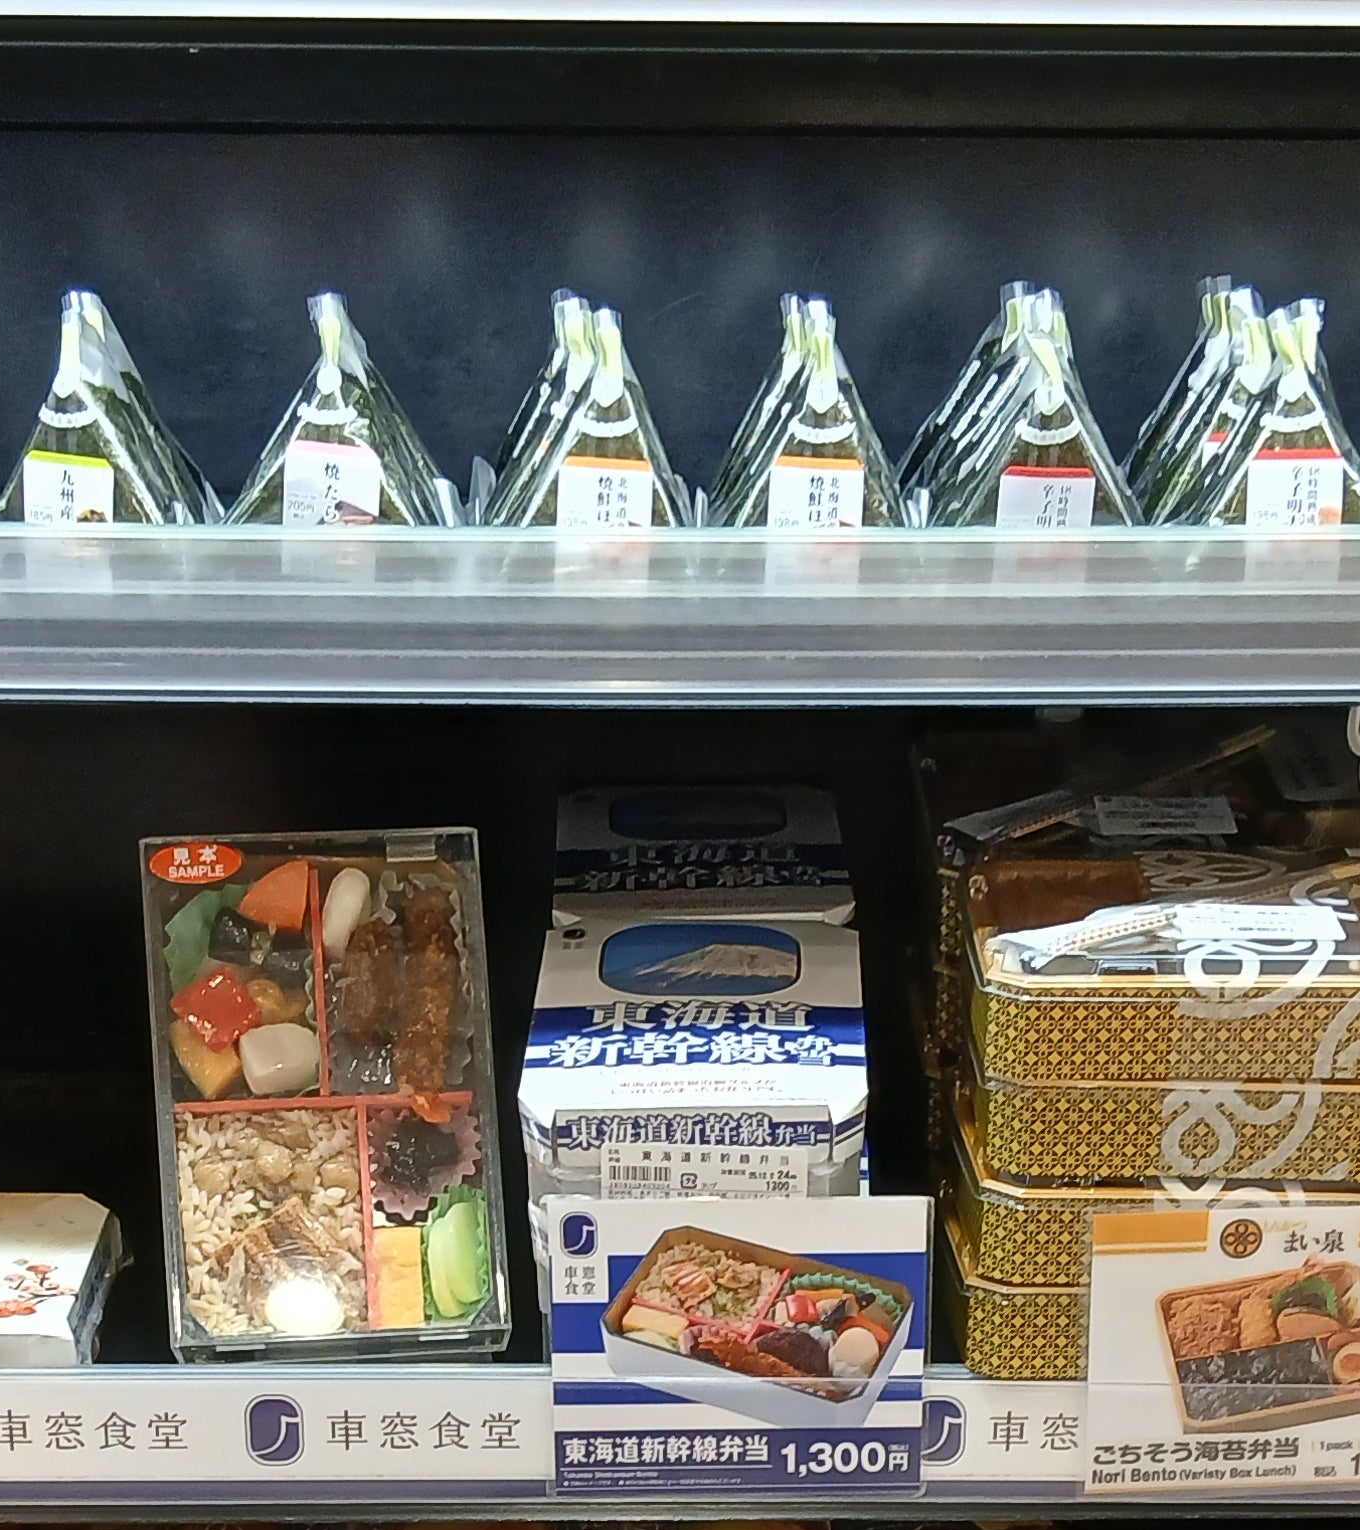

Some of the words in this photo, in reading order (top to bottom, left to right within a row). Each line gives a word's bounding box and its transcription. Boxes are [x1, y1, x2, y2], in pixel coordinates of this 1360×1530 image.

[173, 845, 217, 865] 見本
[168, 864, 225, 878] SAMPLE
[582, 1001, 816, 1033] 東海道
[566, 1112, 818, 1149] 東海道新幹線弁当
[1282, 1229, 1346, 1253] まい泉
[326, 1409, 522, 1452] 車窓食堂
[987, 1411, 1079, 1452] 車窓
[562, 1436, 770, 1465] 東海道新幹線弁当
[781, 1442, 909, 1474] 1,300円
[1093, 1438, 1300, 1465] ごちそう海苔弁当
